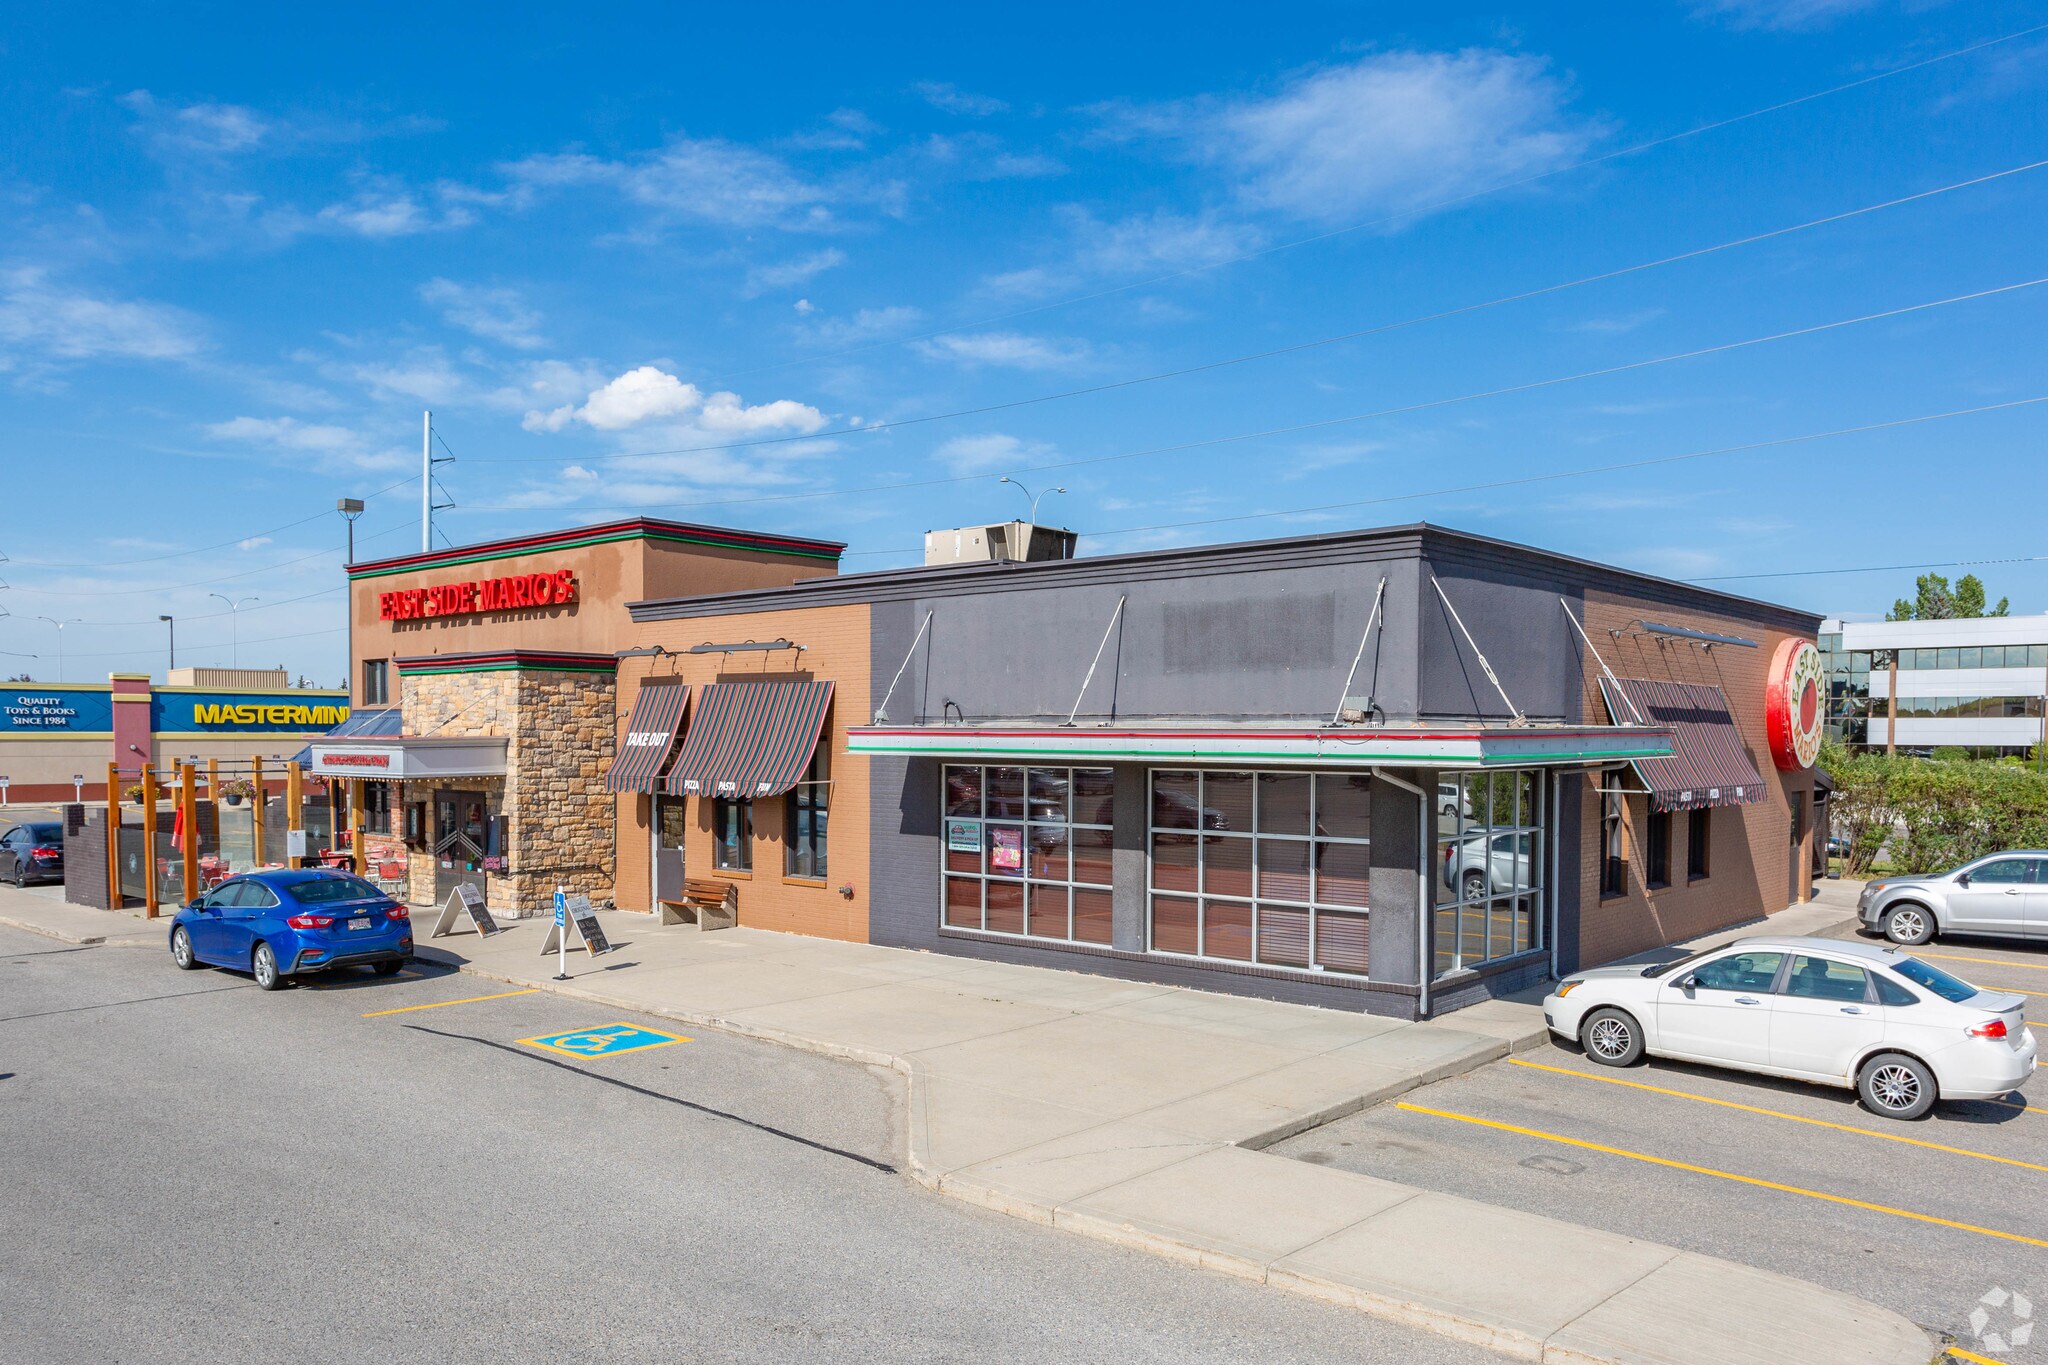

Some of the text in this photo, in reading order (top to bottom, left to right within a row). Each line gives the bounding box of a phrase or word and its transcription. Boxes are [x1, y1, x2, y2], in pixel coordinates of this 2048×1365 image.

[379, 570, 574, 620] EAST SIDE MARIO'S
[1792, 649, 1824, 709] EAST SIDE
[18, 696, 61, 706] QUALITY
[4, 706, 76, 715] TOYS & BOOKS
[12, 717, 66, 725] SINCE 1984
[626, 732, 670, 747] TAKE OUT
[684, 779, 771, 792] PIZZA PASTA FUN
